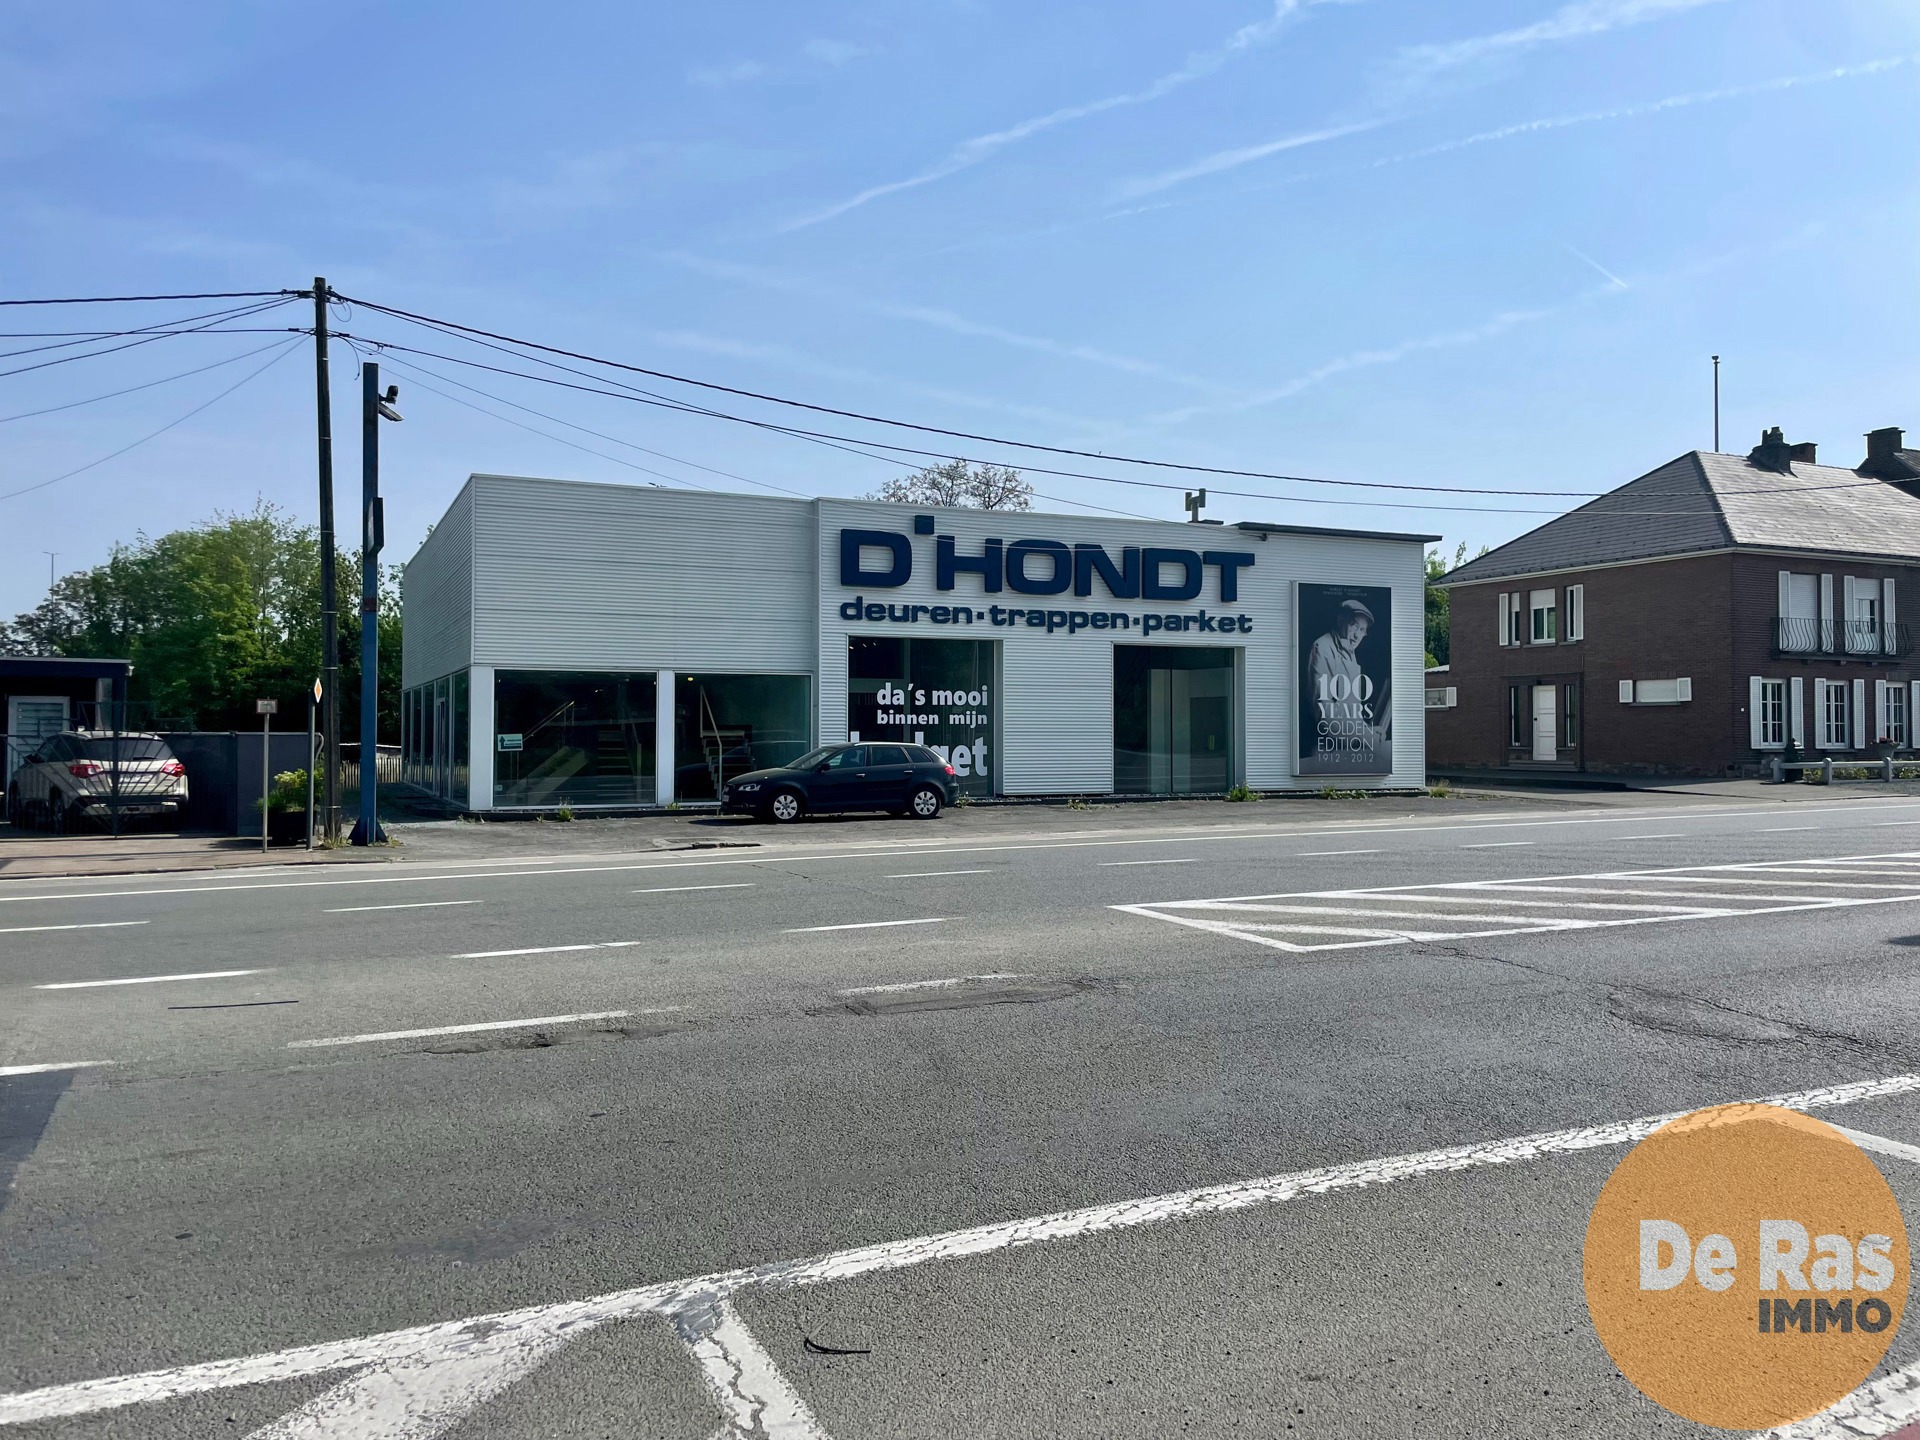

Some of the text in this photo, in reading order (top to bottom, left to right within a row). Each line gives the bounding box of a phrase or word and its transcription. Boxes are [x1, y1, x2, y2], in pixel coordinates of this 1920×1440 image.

[841, 515, 1255, 602] D'HONDT
[840, 596, 1253, 636] deuren trappen parket
[877, 682, 988, 706] da's mooi
[1318, 673, 1374, 702] 100
[877, 709, 988, 729] binnen mijn
[1317, 702, 1374, 719] YEARS
[1317, 720, 1374, 736] GOLDEN
[1317, 736, 1374, 752] EDITION
[1317, 753, 1341, 763] 1912
[1351, 753, 1374, 763] 2012
